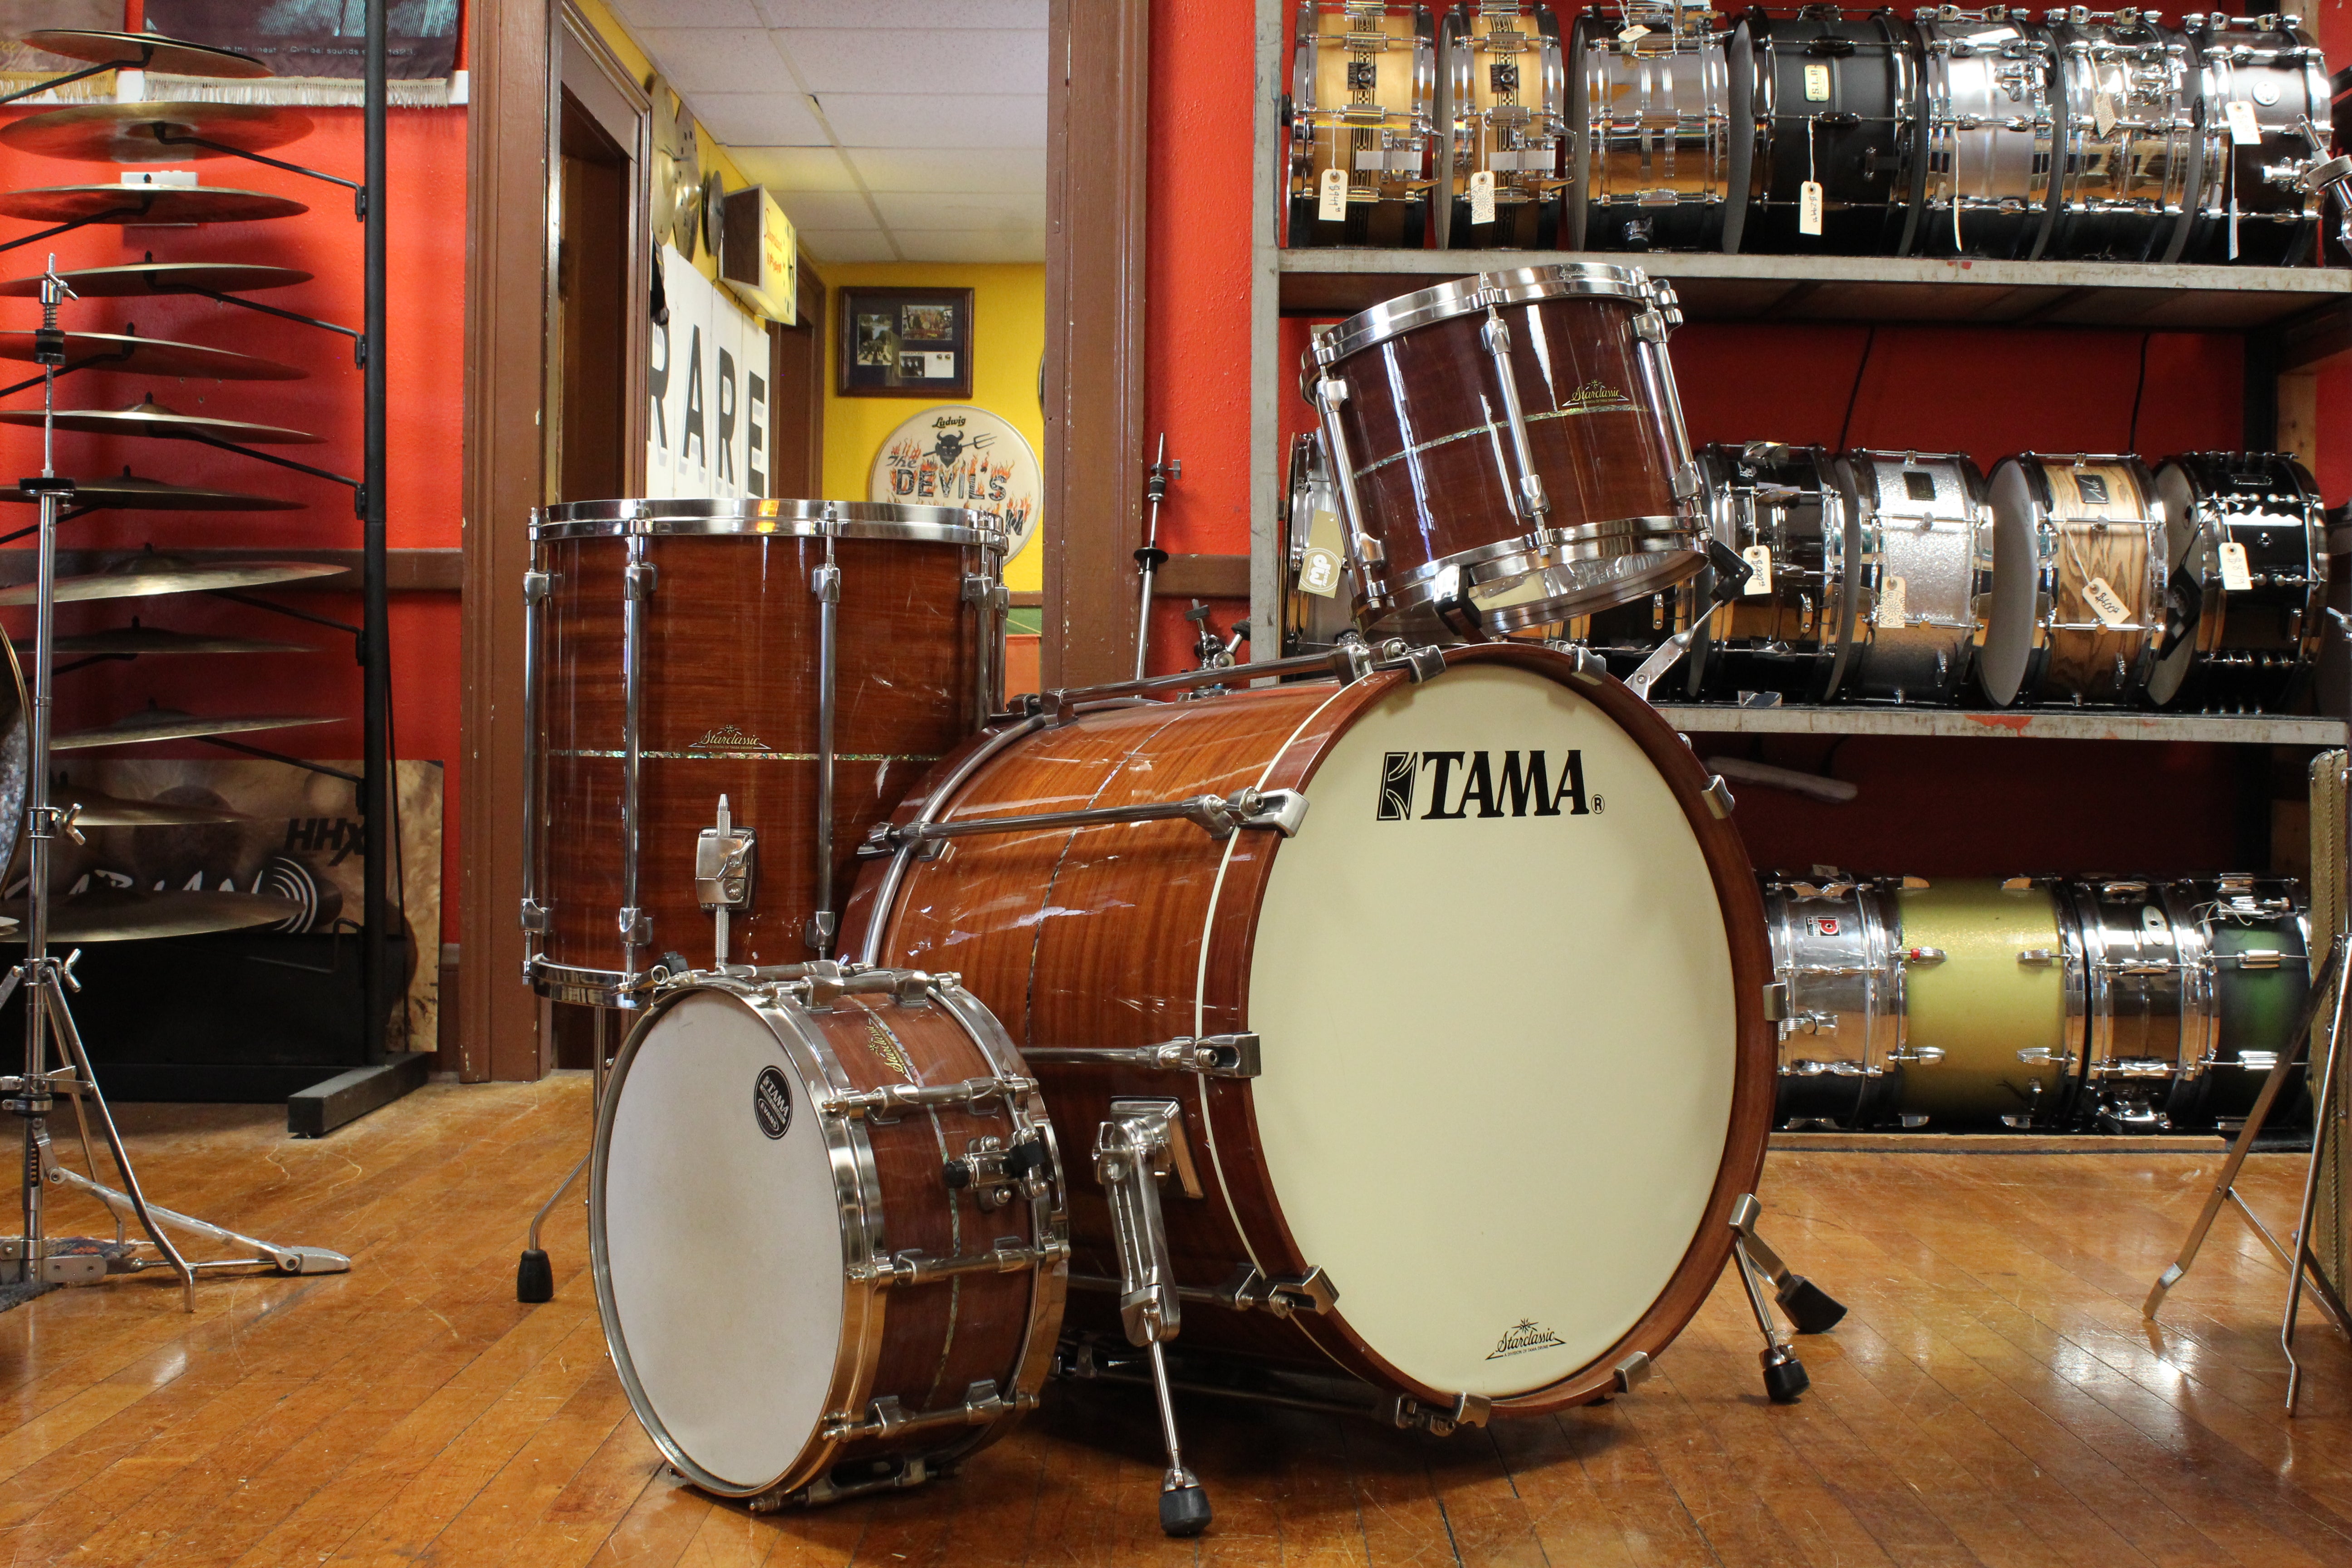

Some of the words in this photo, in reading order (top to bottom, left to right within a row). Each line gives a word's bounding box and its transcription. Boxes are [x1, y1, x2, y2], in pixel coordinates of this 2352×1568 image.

[1570, 386, 1620, 401] Starclassic
[931, 416, 966, 429] Ludwig
[885, 455, 918, 468] The
[896, 466, 1007, 501] DEVIL'S
[698, 730, 760, 745] Starclassic
[1421, 750, 1590, 820] TAMA
[767, 1080, 789, 1117] TAMA
[760, 1101, 777, 1128] EVANS
[1495, 1328, 1555, 1353] Starclassic
